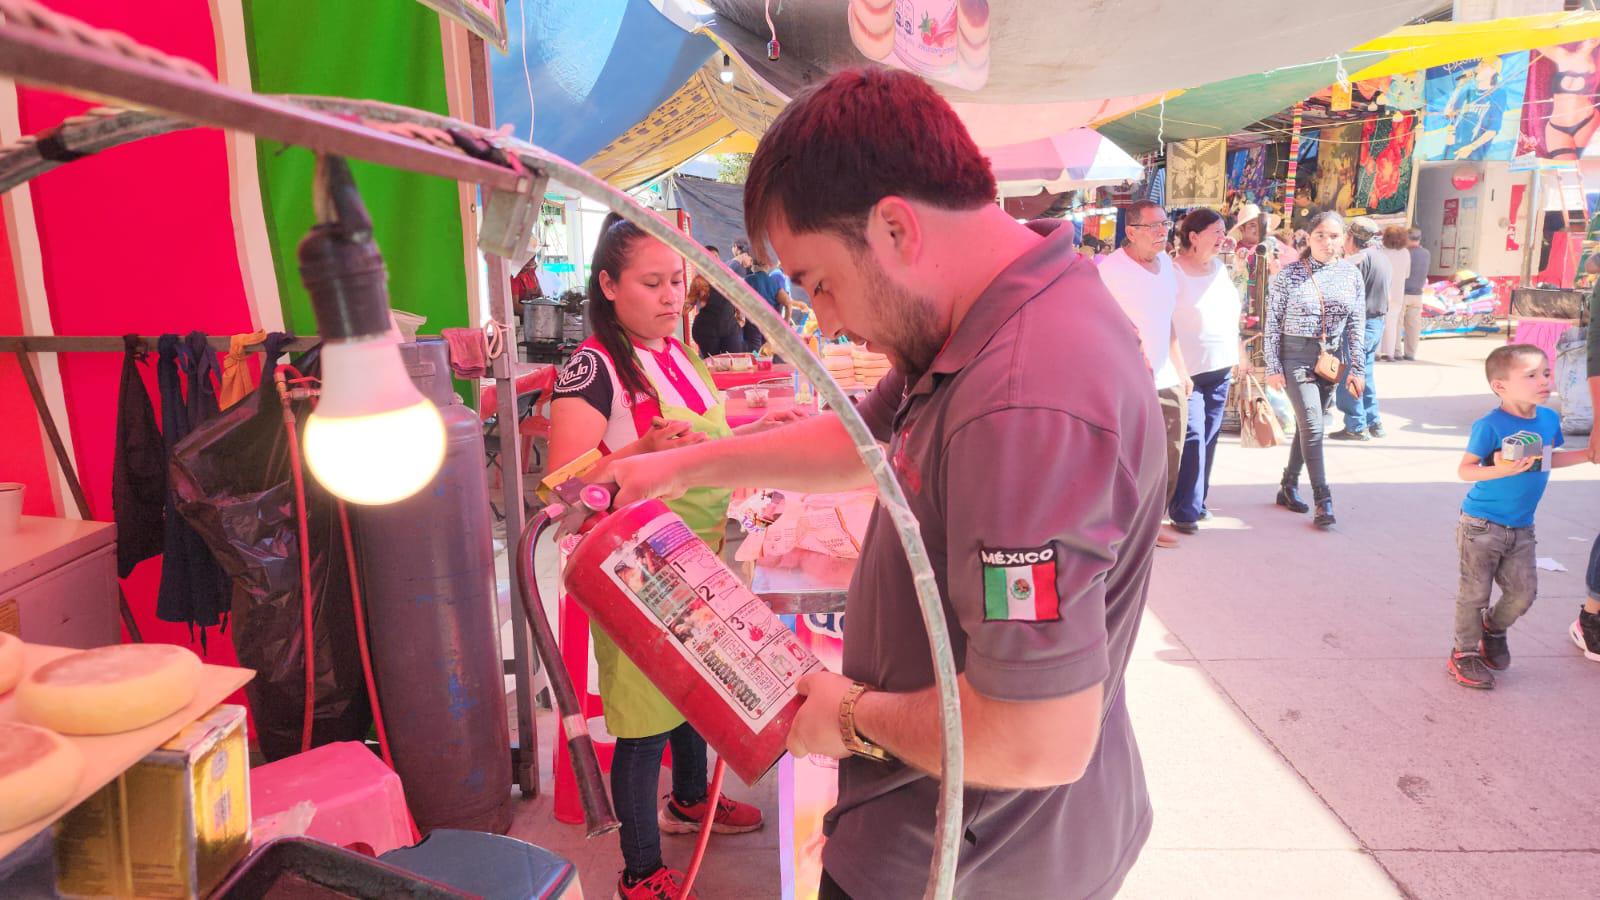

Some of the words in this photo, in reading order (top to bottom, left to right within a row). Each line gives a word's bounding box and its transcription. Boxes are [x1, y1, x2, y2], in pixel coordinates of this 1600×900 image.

[981, 548, 1054, 565] MÉXICO
[673, 561, 687, 574] 1
[699, 585, 715, 602] 2
[730, 616, 745, 631] 3
